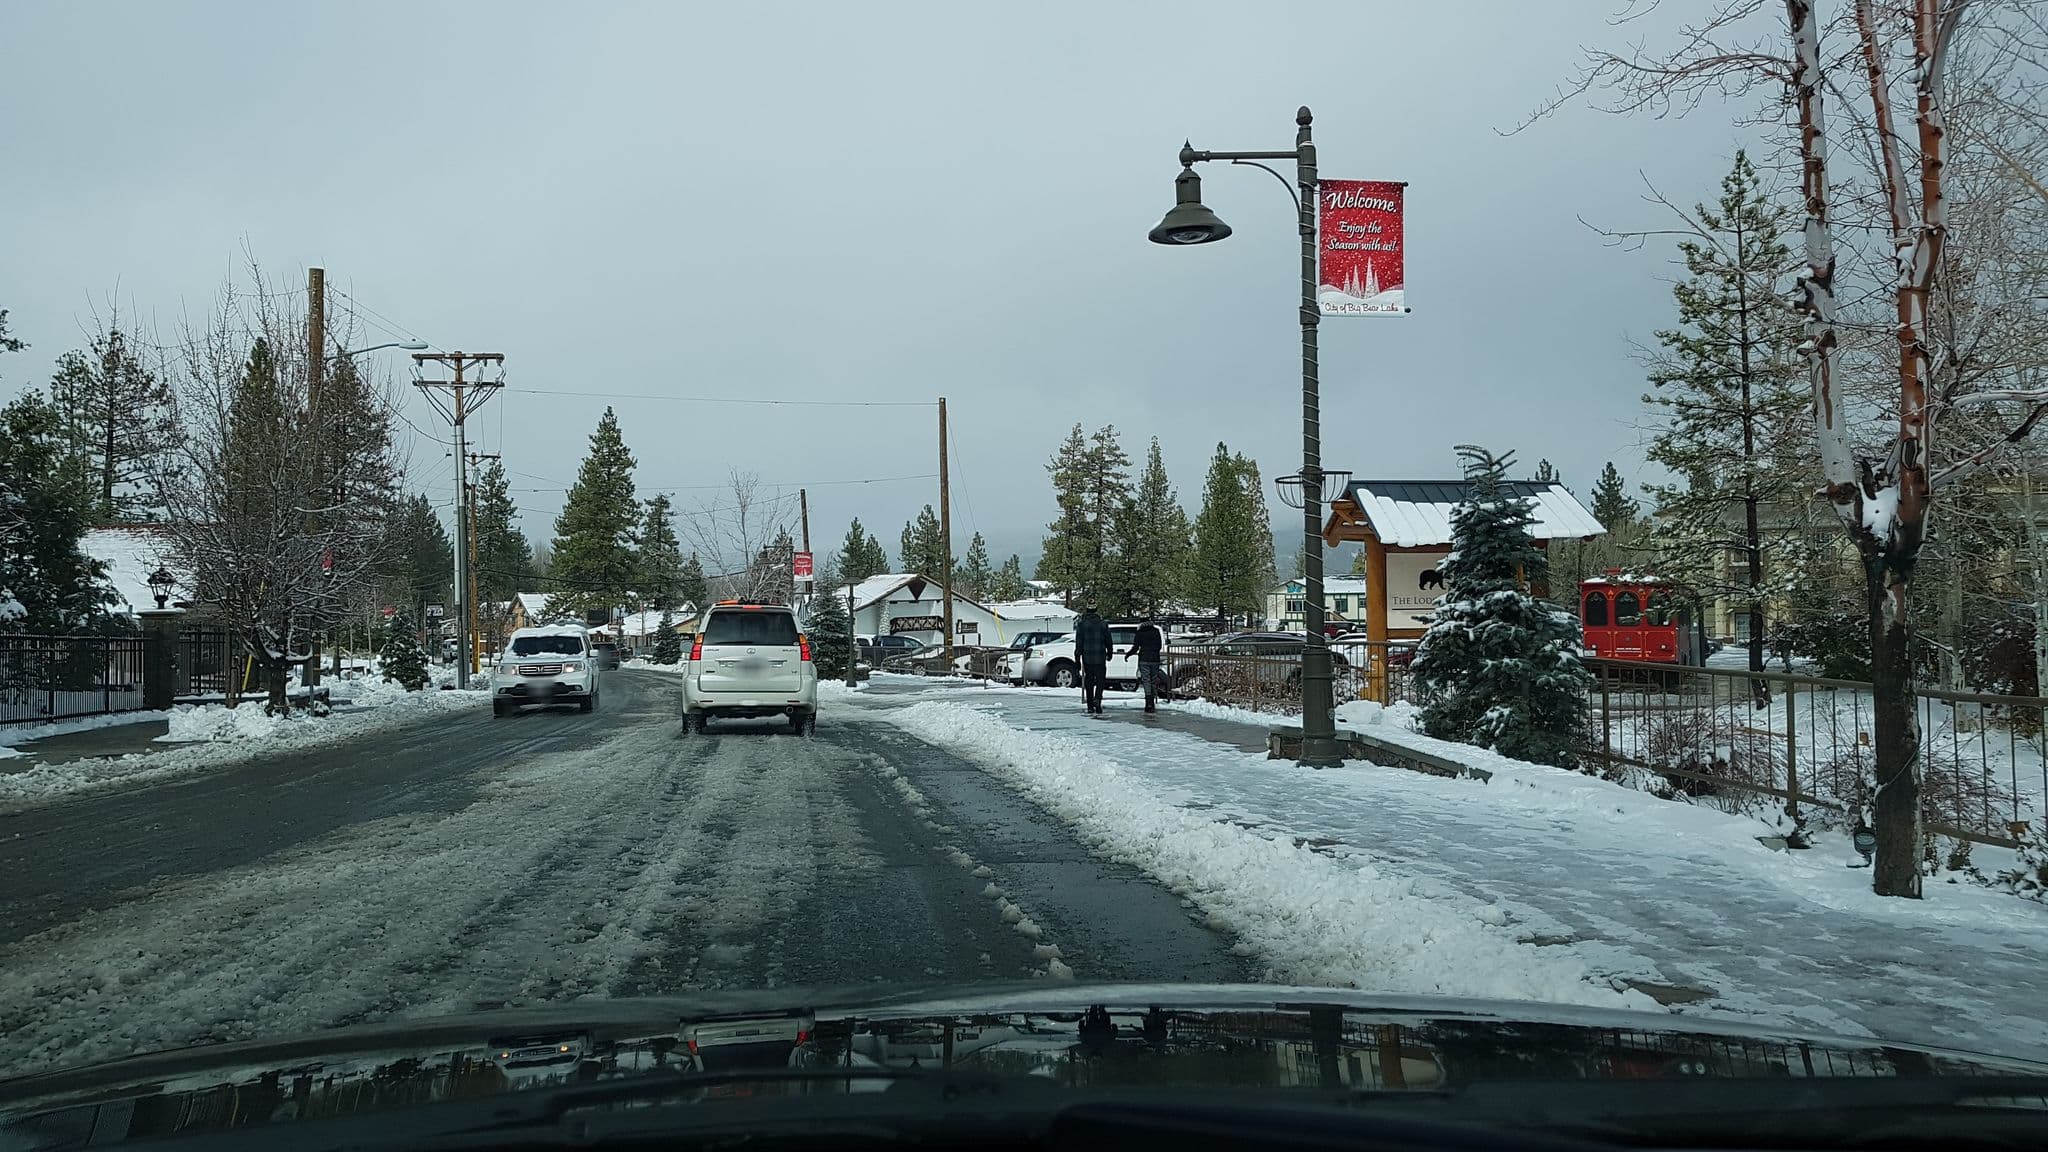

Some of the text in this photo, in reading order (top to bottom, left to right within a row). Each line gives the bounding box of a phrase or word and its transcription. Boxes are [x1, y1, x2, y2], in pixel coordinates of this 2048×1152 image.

[1326, 187, 1397, 213] Welcome.
[1338, 220, 1382, 239] Enjoy the
[1327, 238, 1397, 251] Season with us!
[1325, 302, 1398, 314] City of Big Bear Lake
[1391, 596, 1434, 605] THE LOD
